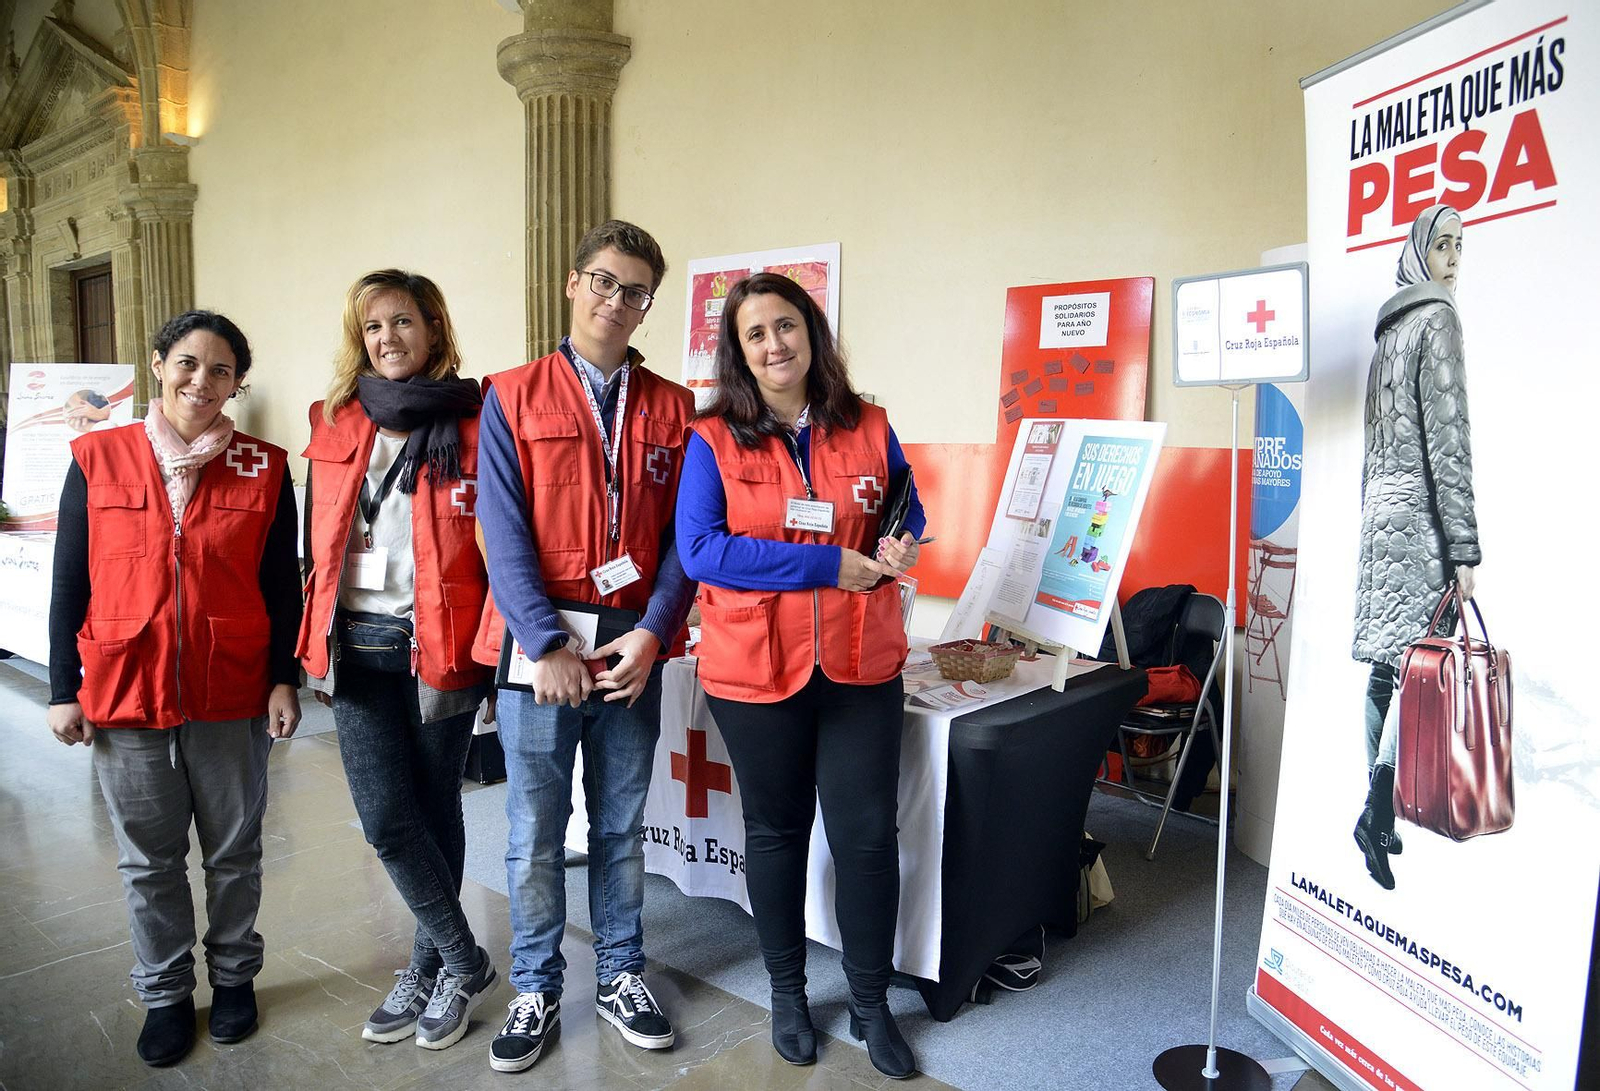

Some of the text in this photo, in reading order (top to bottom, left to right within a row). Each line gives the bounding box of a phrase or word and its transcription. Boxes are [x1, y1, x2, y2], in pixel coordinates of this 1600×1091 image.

[1350, 35, 1565, 161] LA MALETA QUE MÁS
[1346, 108, 1558, 238] PESA
[1054, 311, 1096, 319] SOLIDARIOS
[1225, 335, 1299, 351] Cruz Roja Española
[1072, 461, 1138, 496] EN JUEGO
[1081, 443, 1143, 465] SUS DERECHOS
[1262, 469, 1281, 478] APOYO
[1262, 477, 1290, 487] MAYORES
[641, 825, 670, 847] ruz
[704, 838, 745, 875] Espa
[1291, 871, 1523, 1024] LAMALETAQUEMASPESA.COM
[1310, 916, 1332, 938] PERSONAS
[1381, 960, 1397, 979] HACER
[1405, 976, 1425, 997] MALETA
[1426, 989, 1438, 1005] QUE
[1493, 1032, 1505, 1049] LAS
[1342, 947, 1362, 968] MALETAS
[1382, 973, 1395, 990] CRUZ
[1395, 982, 1407, 998] ROJA
[1457, 1022, 1472, 1041] PESO
[1481, 1038, 1496, 1057] ESTE
[1320, 1025, 1334, 1041] Cada
[1375, 1068, 1384, 1080] de
